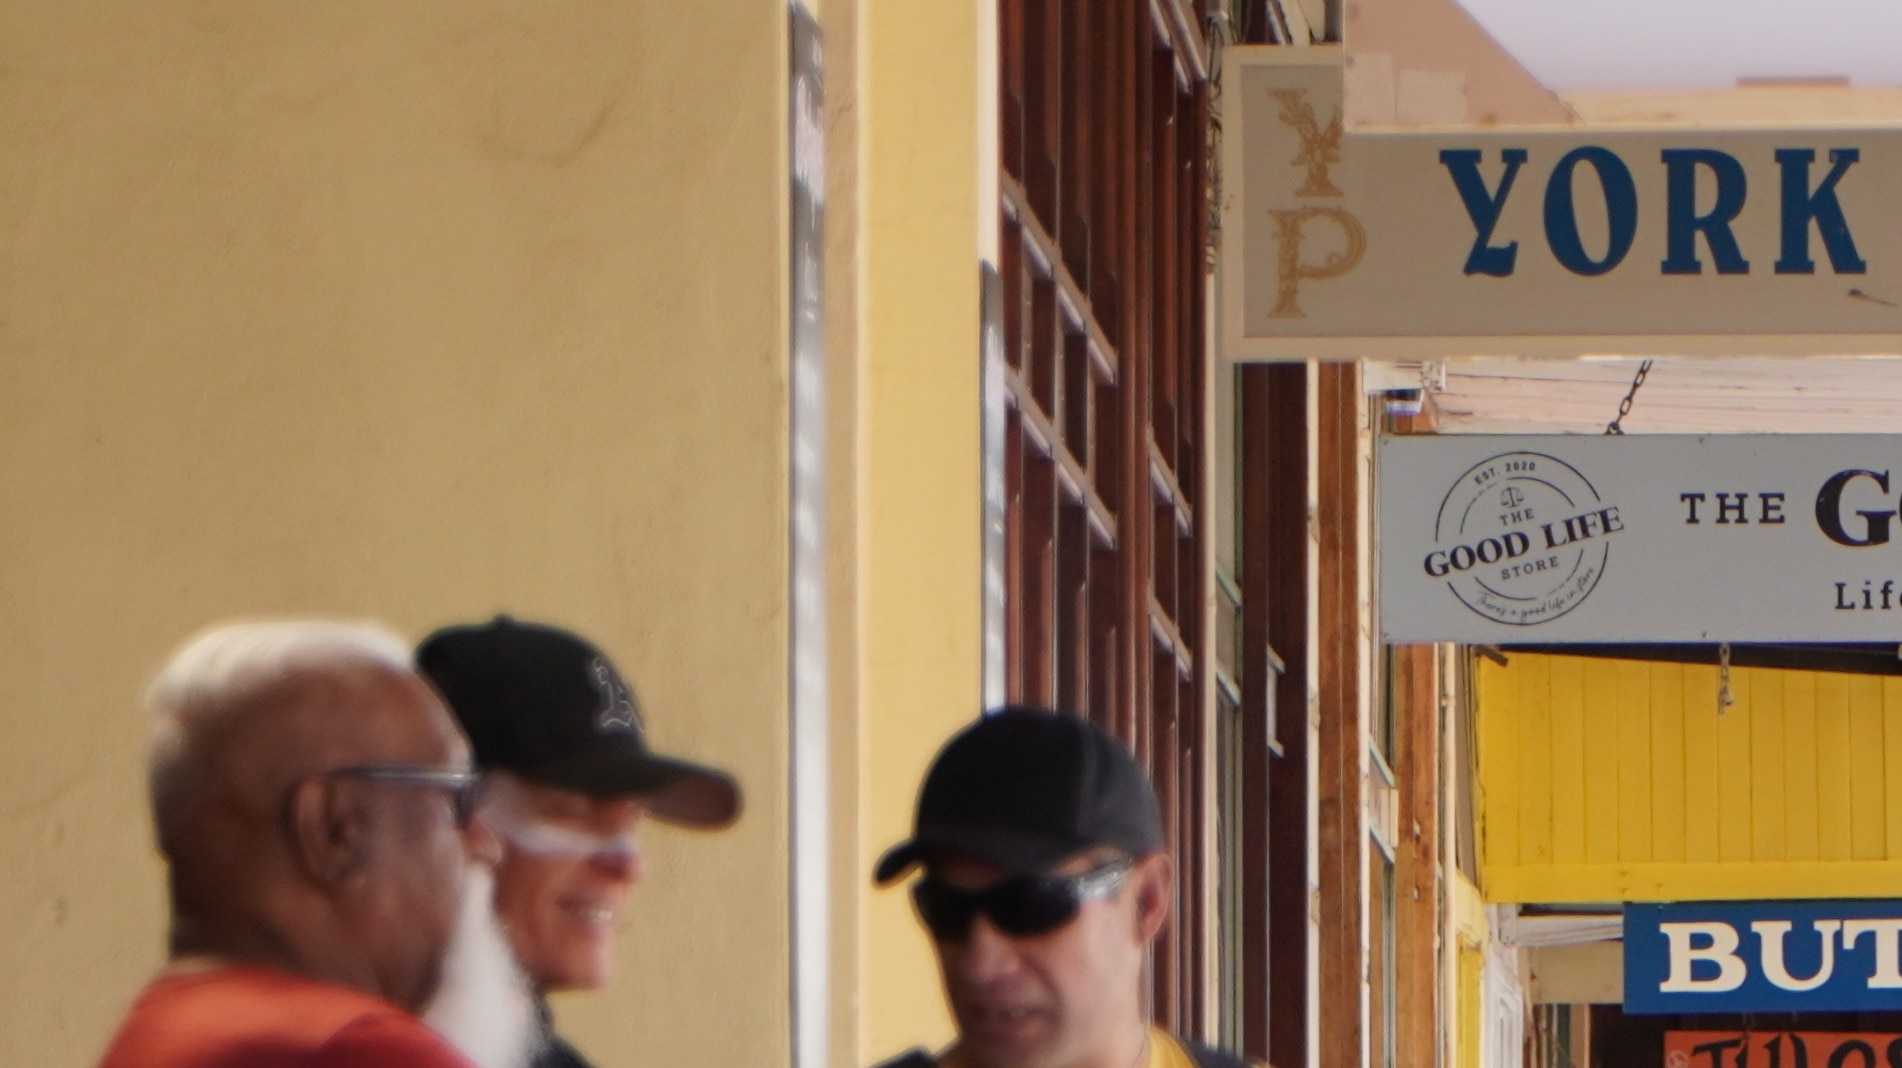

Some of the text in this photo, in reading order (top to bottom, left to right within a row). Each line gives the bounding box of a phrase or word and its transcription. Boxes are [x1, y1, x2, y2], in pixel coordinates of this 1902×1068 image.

[1438, 145, 1867, 277] YORK
[1499, 508, 1535, 526] THE
[1680, 492, 1787, 525] THE
[1423, 505, 1625, 578] GOOD LIFE
[1500, 556, 1560, 580] STORE
